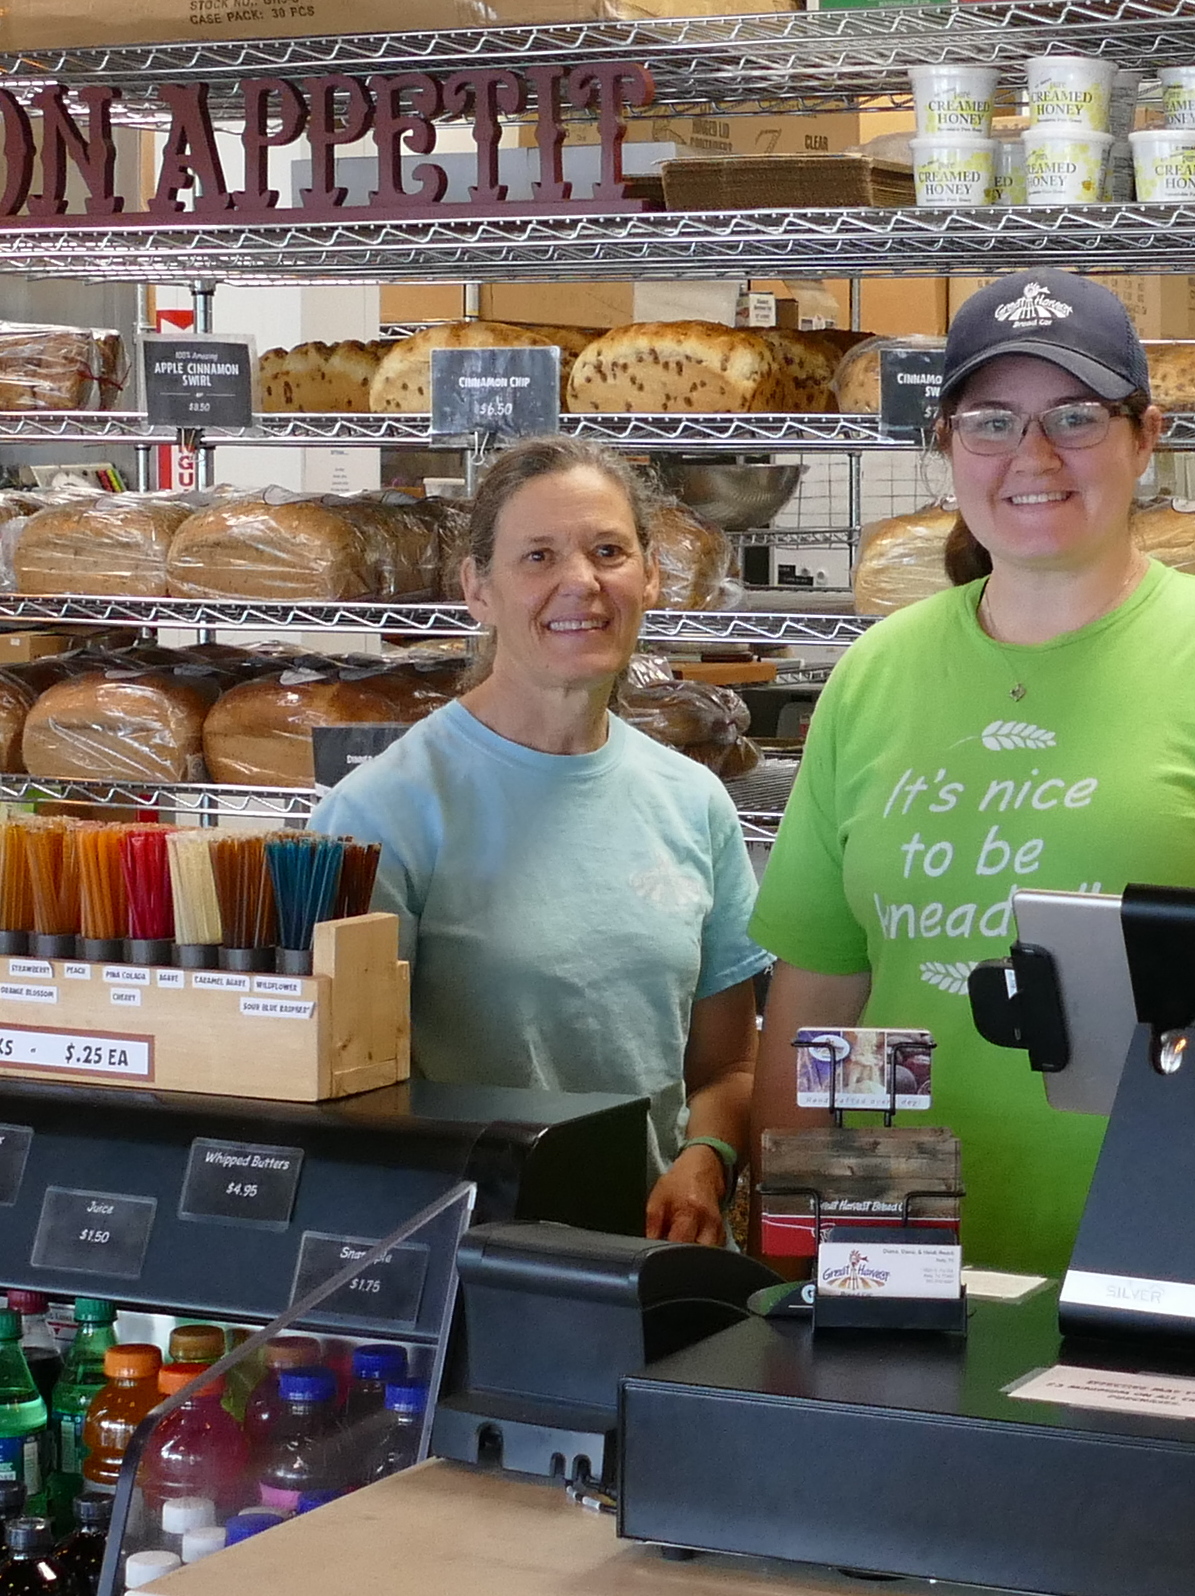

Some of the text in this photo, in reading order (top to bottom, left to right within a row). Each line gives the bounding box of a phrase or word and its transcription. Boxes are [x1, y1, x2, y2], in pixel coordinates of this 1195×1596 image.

[190, 5, 315, 25] CASE PACK: 30 PCS
[929, 101, 990, 112] CREAMED
[1037, 104, 1084, 115] HONEY
[938, 113, 984, 125] HONEY
[146, 62, 655, 213] APPETIT
[804, 134, 829, 151] CLEAR
[919, 171, 981, 182] CREAMED
[925, 184, 972, 195] HONEY
[154, 362, 239, 375] APPLE CINNAMON
[182, 375, 211, 386] SWIRL
[458, 377, 530, 387] CINNAMON CHIP
[480, 402, 512, 415] $6.50
[883, 767, 1098, 819] It's nice
[901, 825, 1044, 878] to be
[66, 966, 86, 975] PEACH
[256, 981, 297, 991] WILDFLOWER
[243, 1002, 260, 1011] SOUR
[65, 1042, 103, 1064] $.25
[108, 1048, 129, 1067] EA
[205, 1151, 290, 1170] Whipped Butters
[226, 1182, 258, 1197] $4.95
[86, 1201, 115, 1214] Juice
[79, 1229, 110, 1244] $1.50
[340, 1246, 393, 1265] Snale
[857, 1264, 890, 1282] Harvest
[350, 1279, 380, 1293] $1.75
[1106, 1285, 1162, 1303] SILVER
